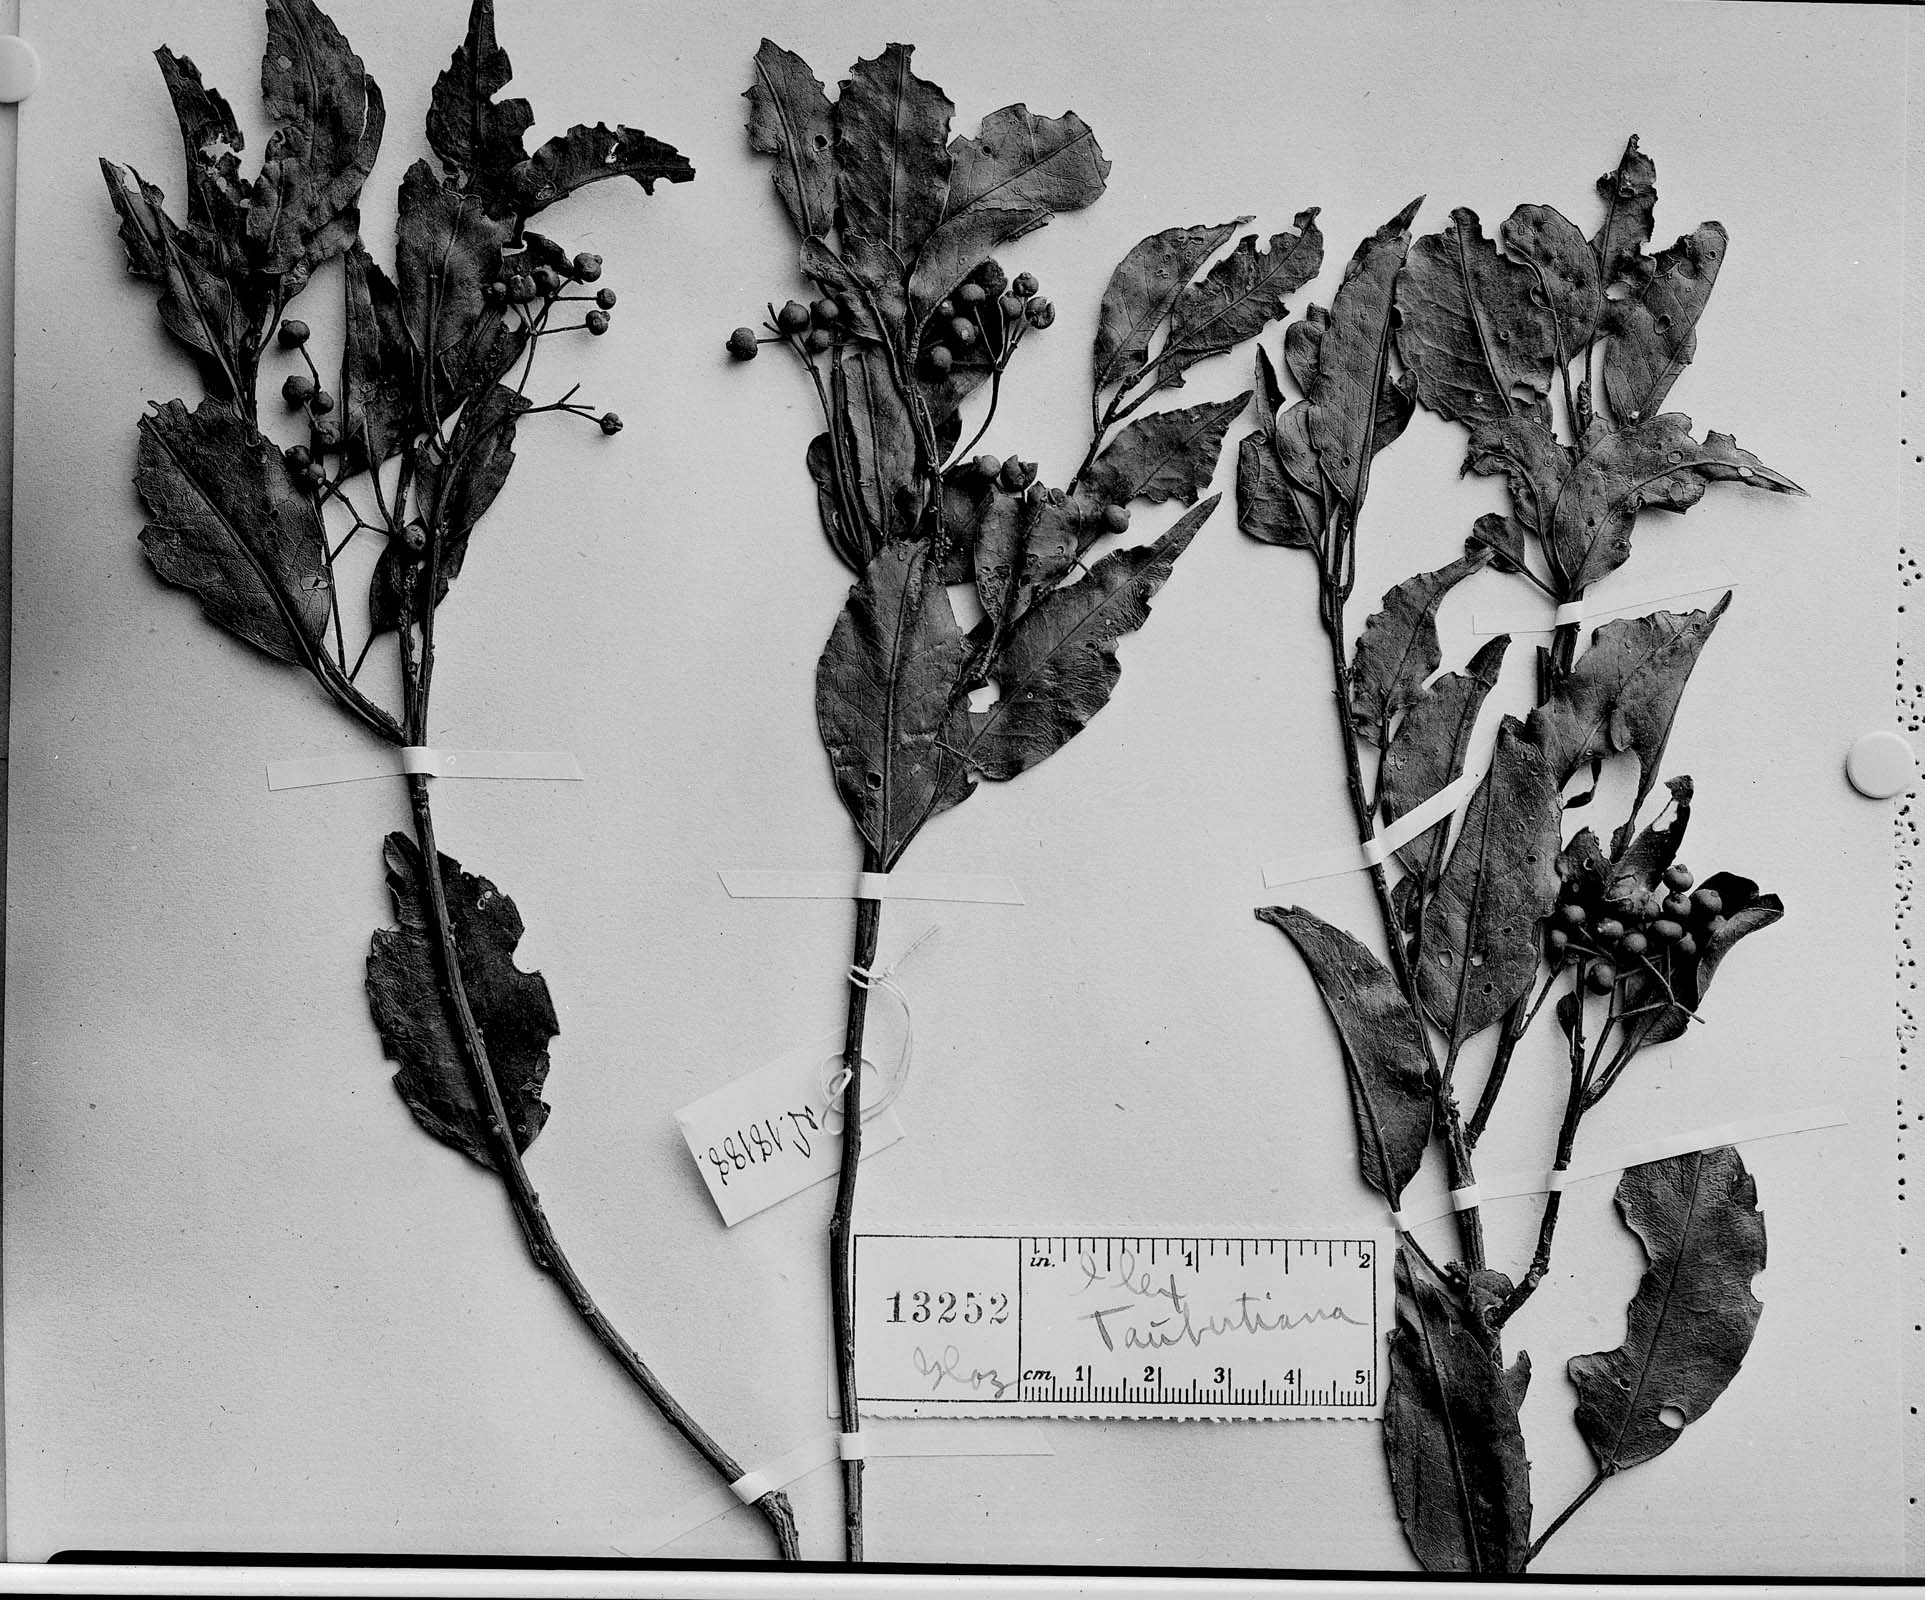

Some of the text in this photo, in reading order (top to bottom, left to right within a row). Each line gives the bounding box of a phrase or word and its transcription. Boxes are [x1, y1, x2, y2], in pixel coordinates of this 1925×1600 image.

[1184, 1251, 1194, 1267] 1
[1358, 1252, 1371, 1269] 2
[886, 1289, 1010, 1325] 13252
[1075, 1365, 1085, 1382] 1
[1143, 1365, 1156, 1383] 2
[1213, 1366, 1225, 1384] 3
[1283, 1368, 1295, 1385] 4
[1354, 1369, 1367, 1385] 5
